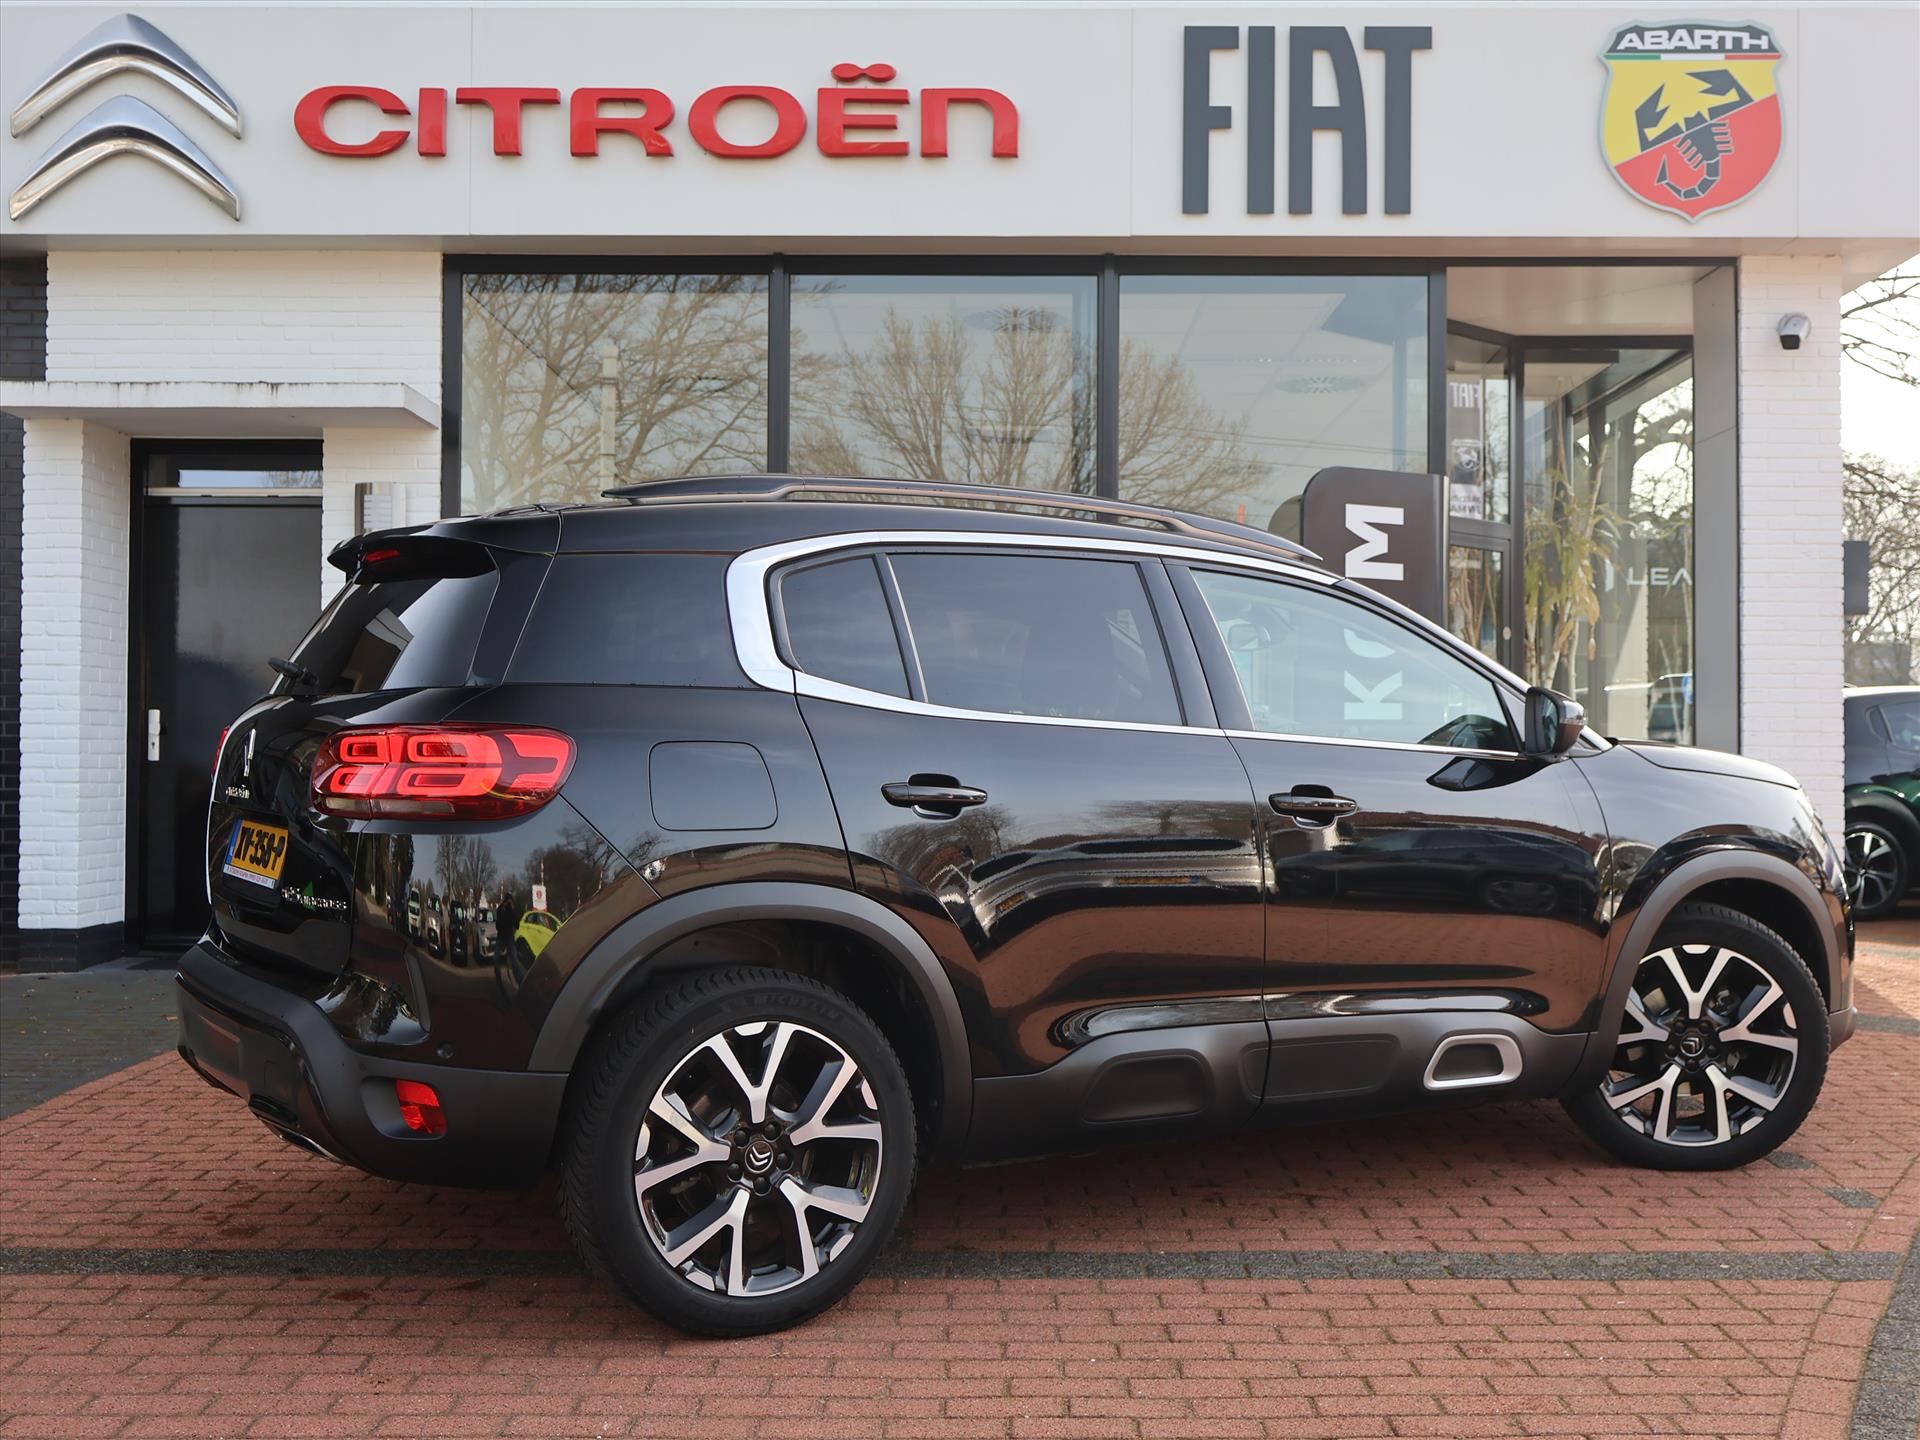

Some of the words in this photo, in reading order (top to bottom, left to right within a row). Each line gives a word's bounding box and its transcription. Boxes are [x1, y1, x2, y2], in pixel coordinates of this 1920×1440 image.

[1616, 28, 1769, 51] ABARTH
[294, 62, 1020, 158] CITROËN
[1182, 25, 1433, 214] FIAT
